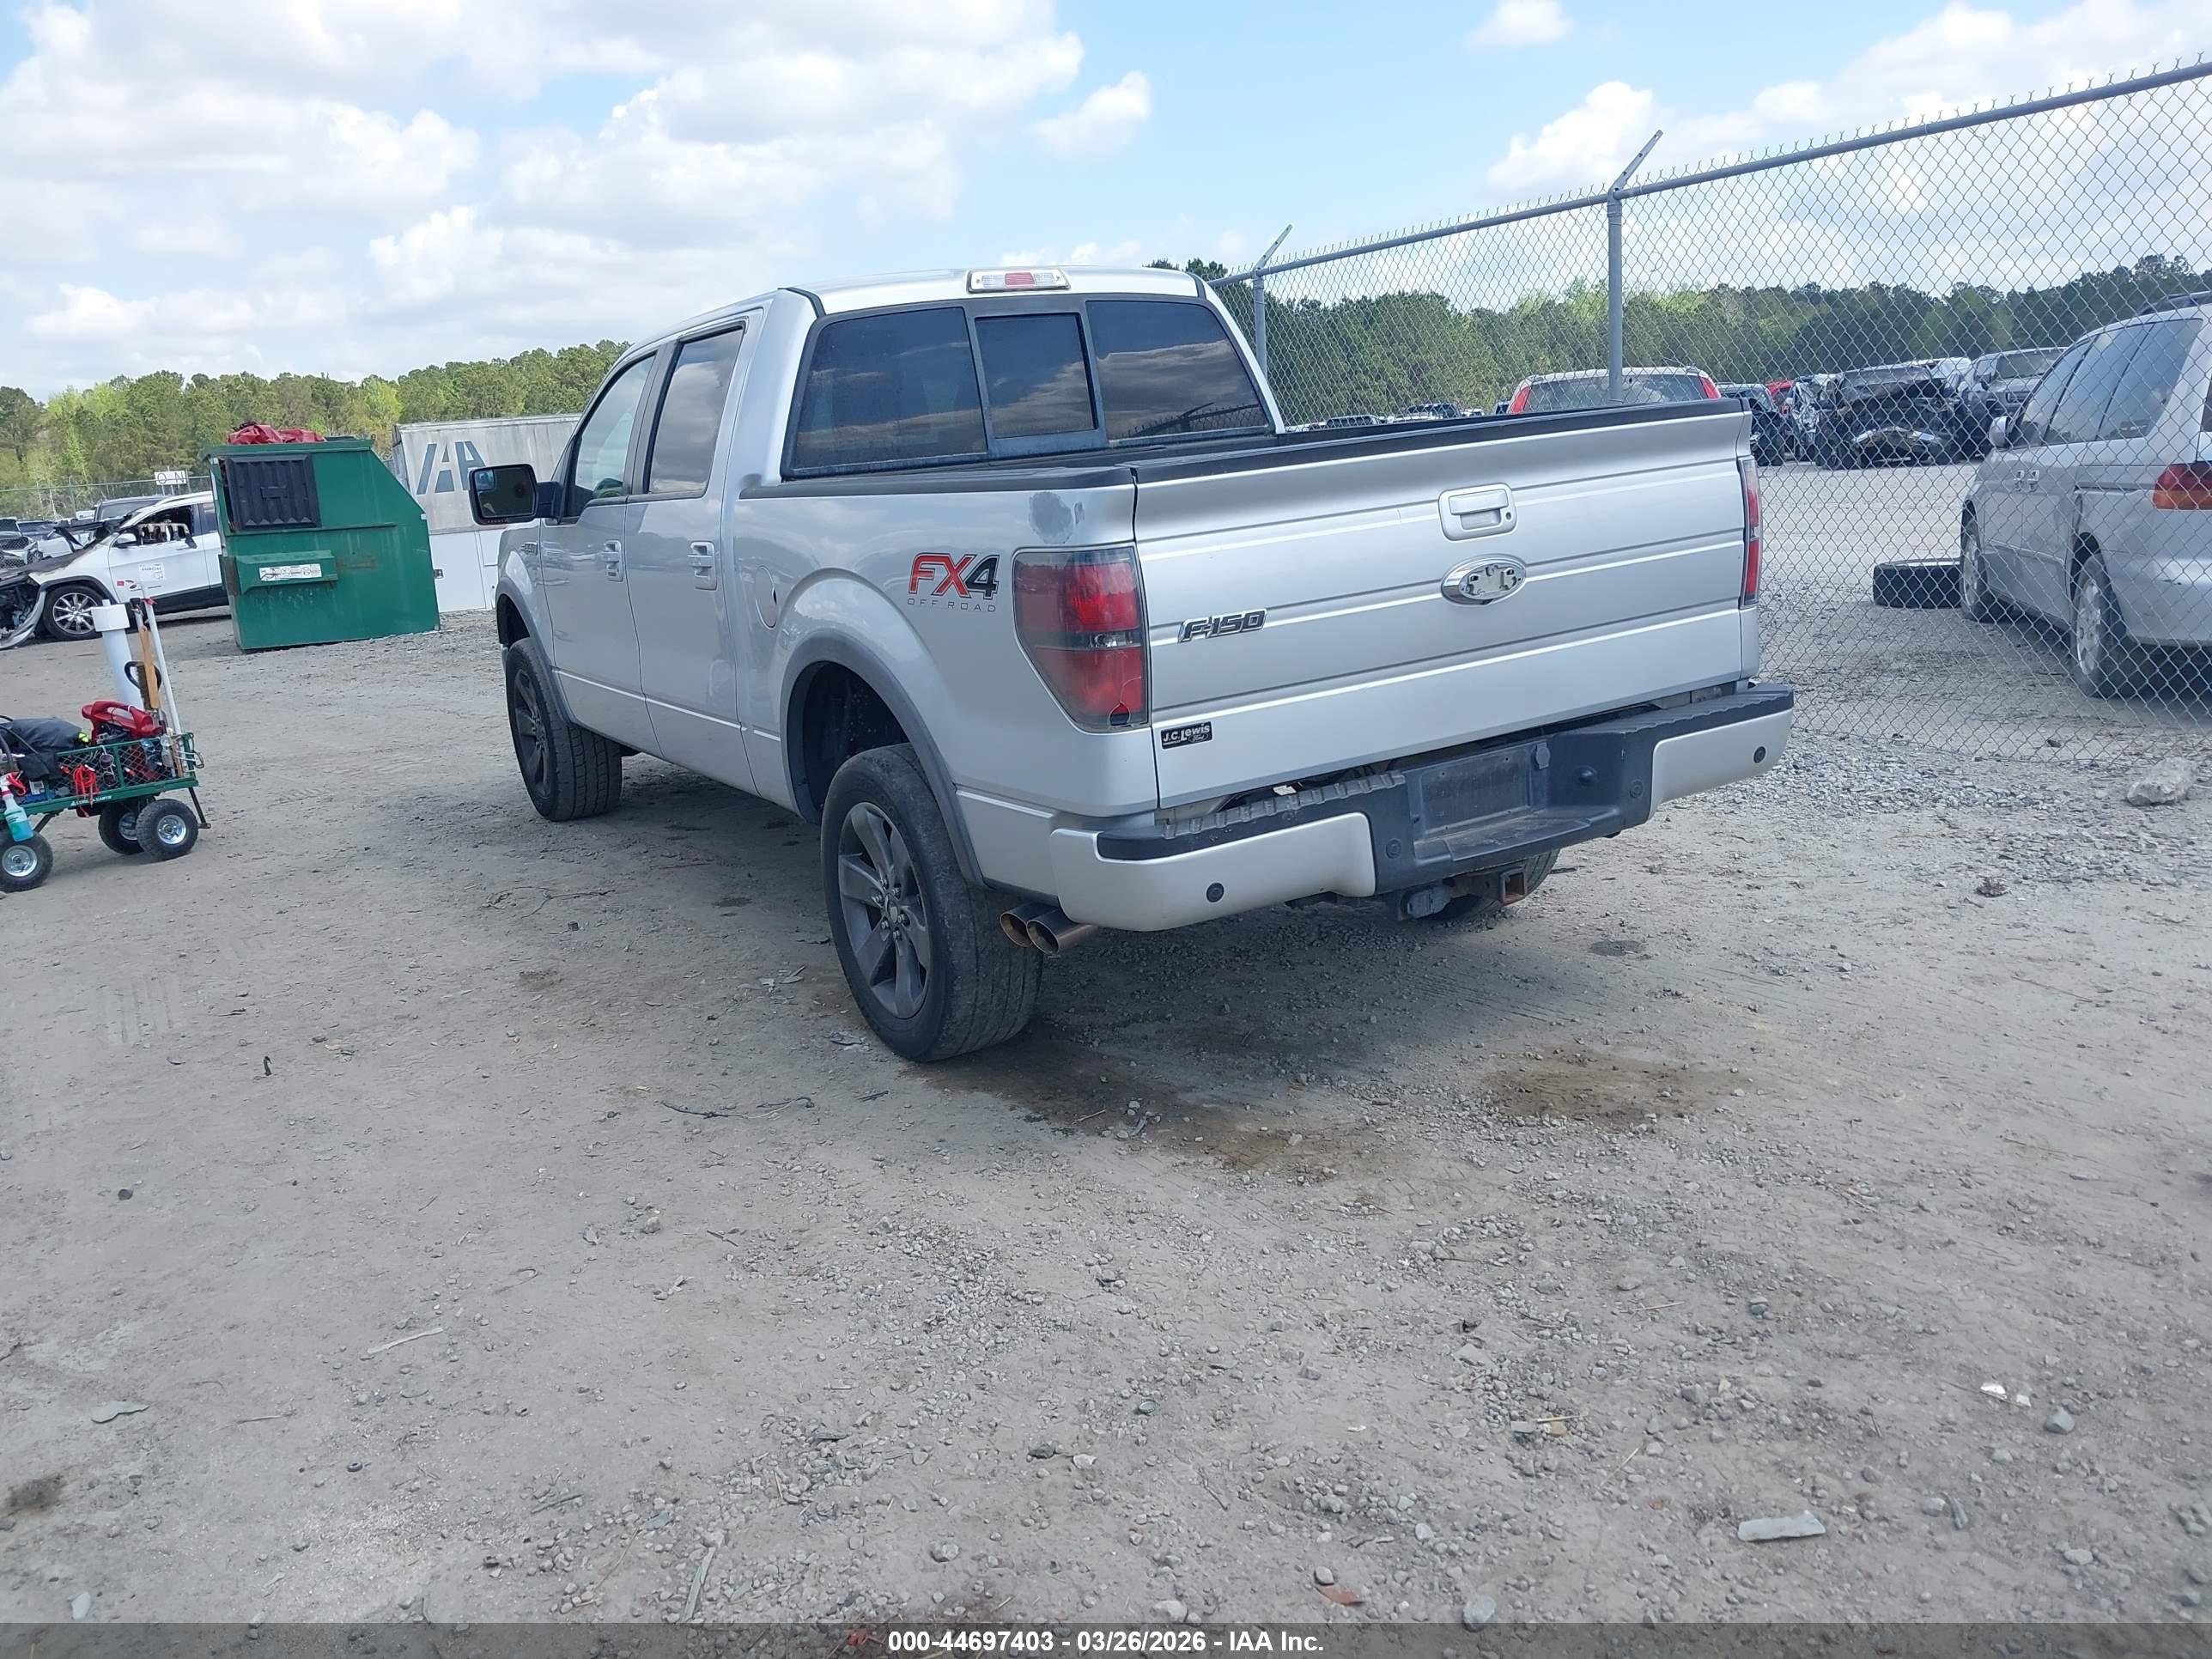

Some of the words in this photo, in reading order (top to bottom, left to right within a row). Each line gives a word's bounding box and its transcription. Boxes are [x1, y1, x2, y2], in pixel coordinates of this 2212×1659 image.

[908, 552, 1000, 600] FX4
[947, 601, 996, 612] ROAD
[1178, 609, 1267, 643] F-150
